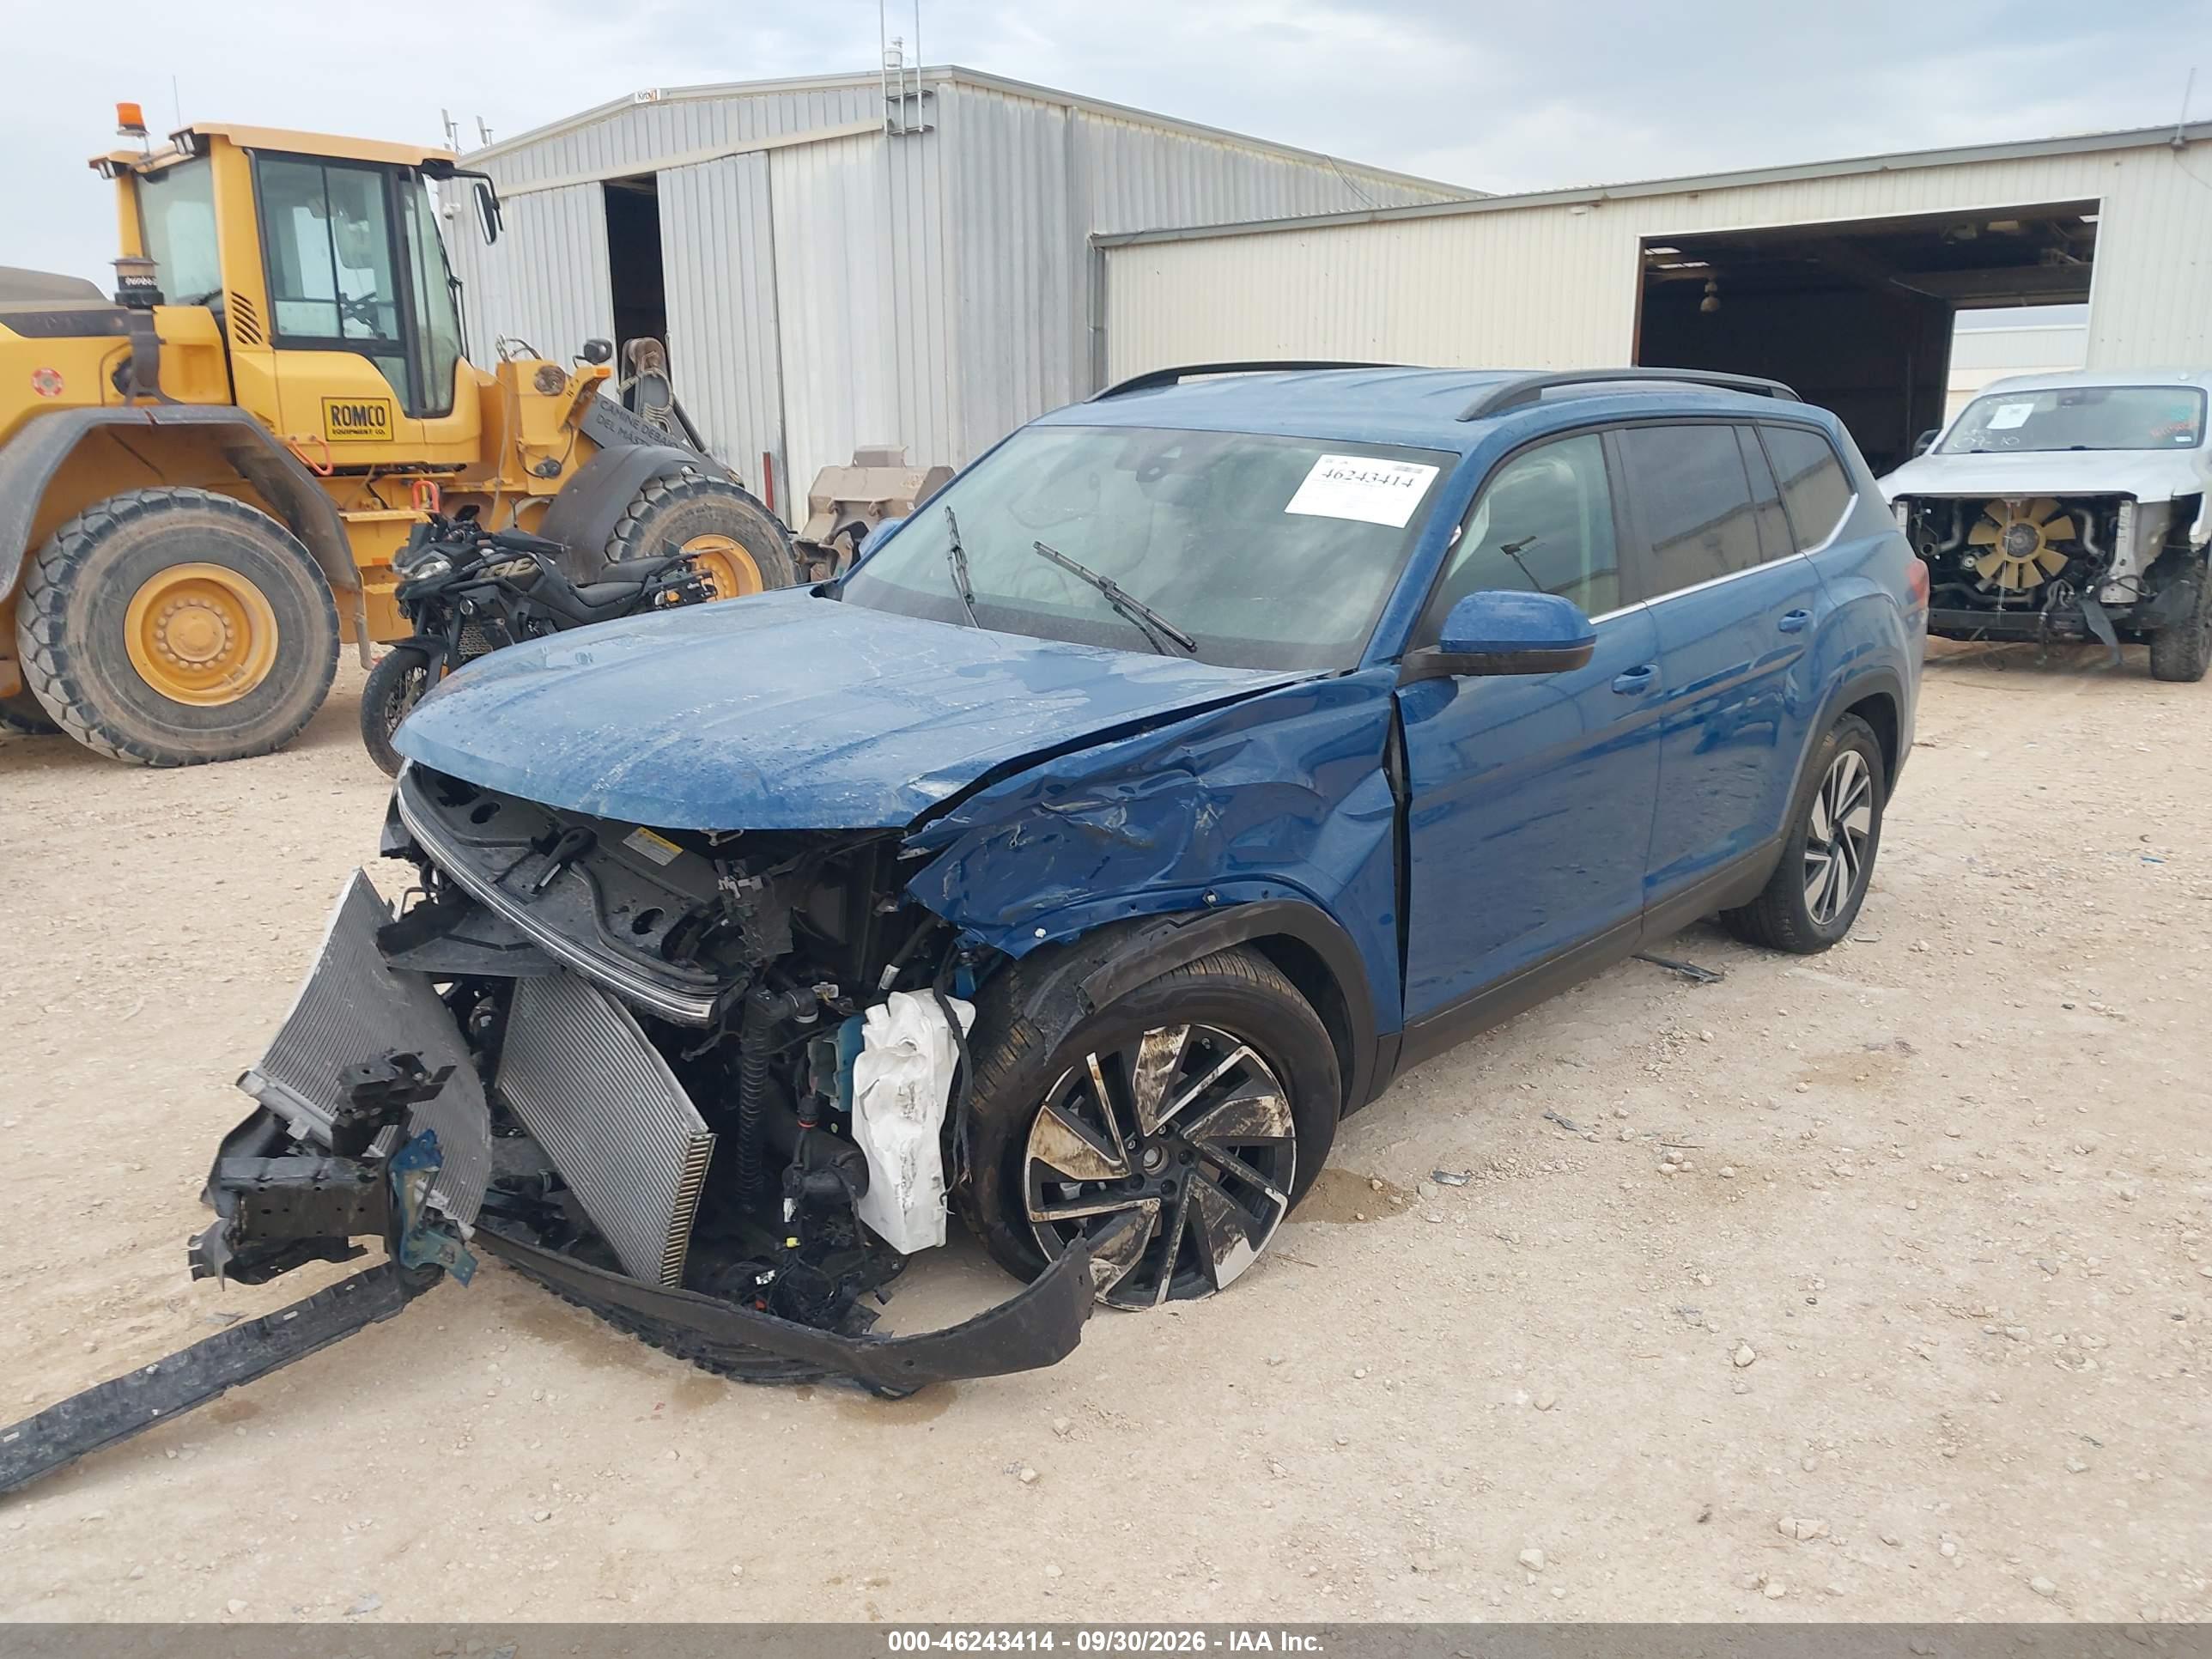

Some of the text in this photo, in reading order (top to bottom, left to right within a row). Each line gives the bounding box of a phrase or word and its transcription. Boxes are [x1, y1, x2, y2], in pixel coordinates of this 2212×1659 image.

[331, 404, 386, 427] ROMCO
[596, 413, 617, 432] DEL
[600, 400, 641, 430] CAMINE
[1322, 469, 1413, 488] 46243414
